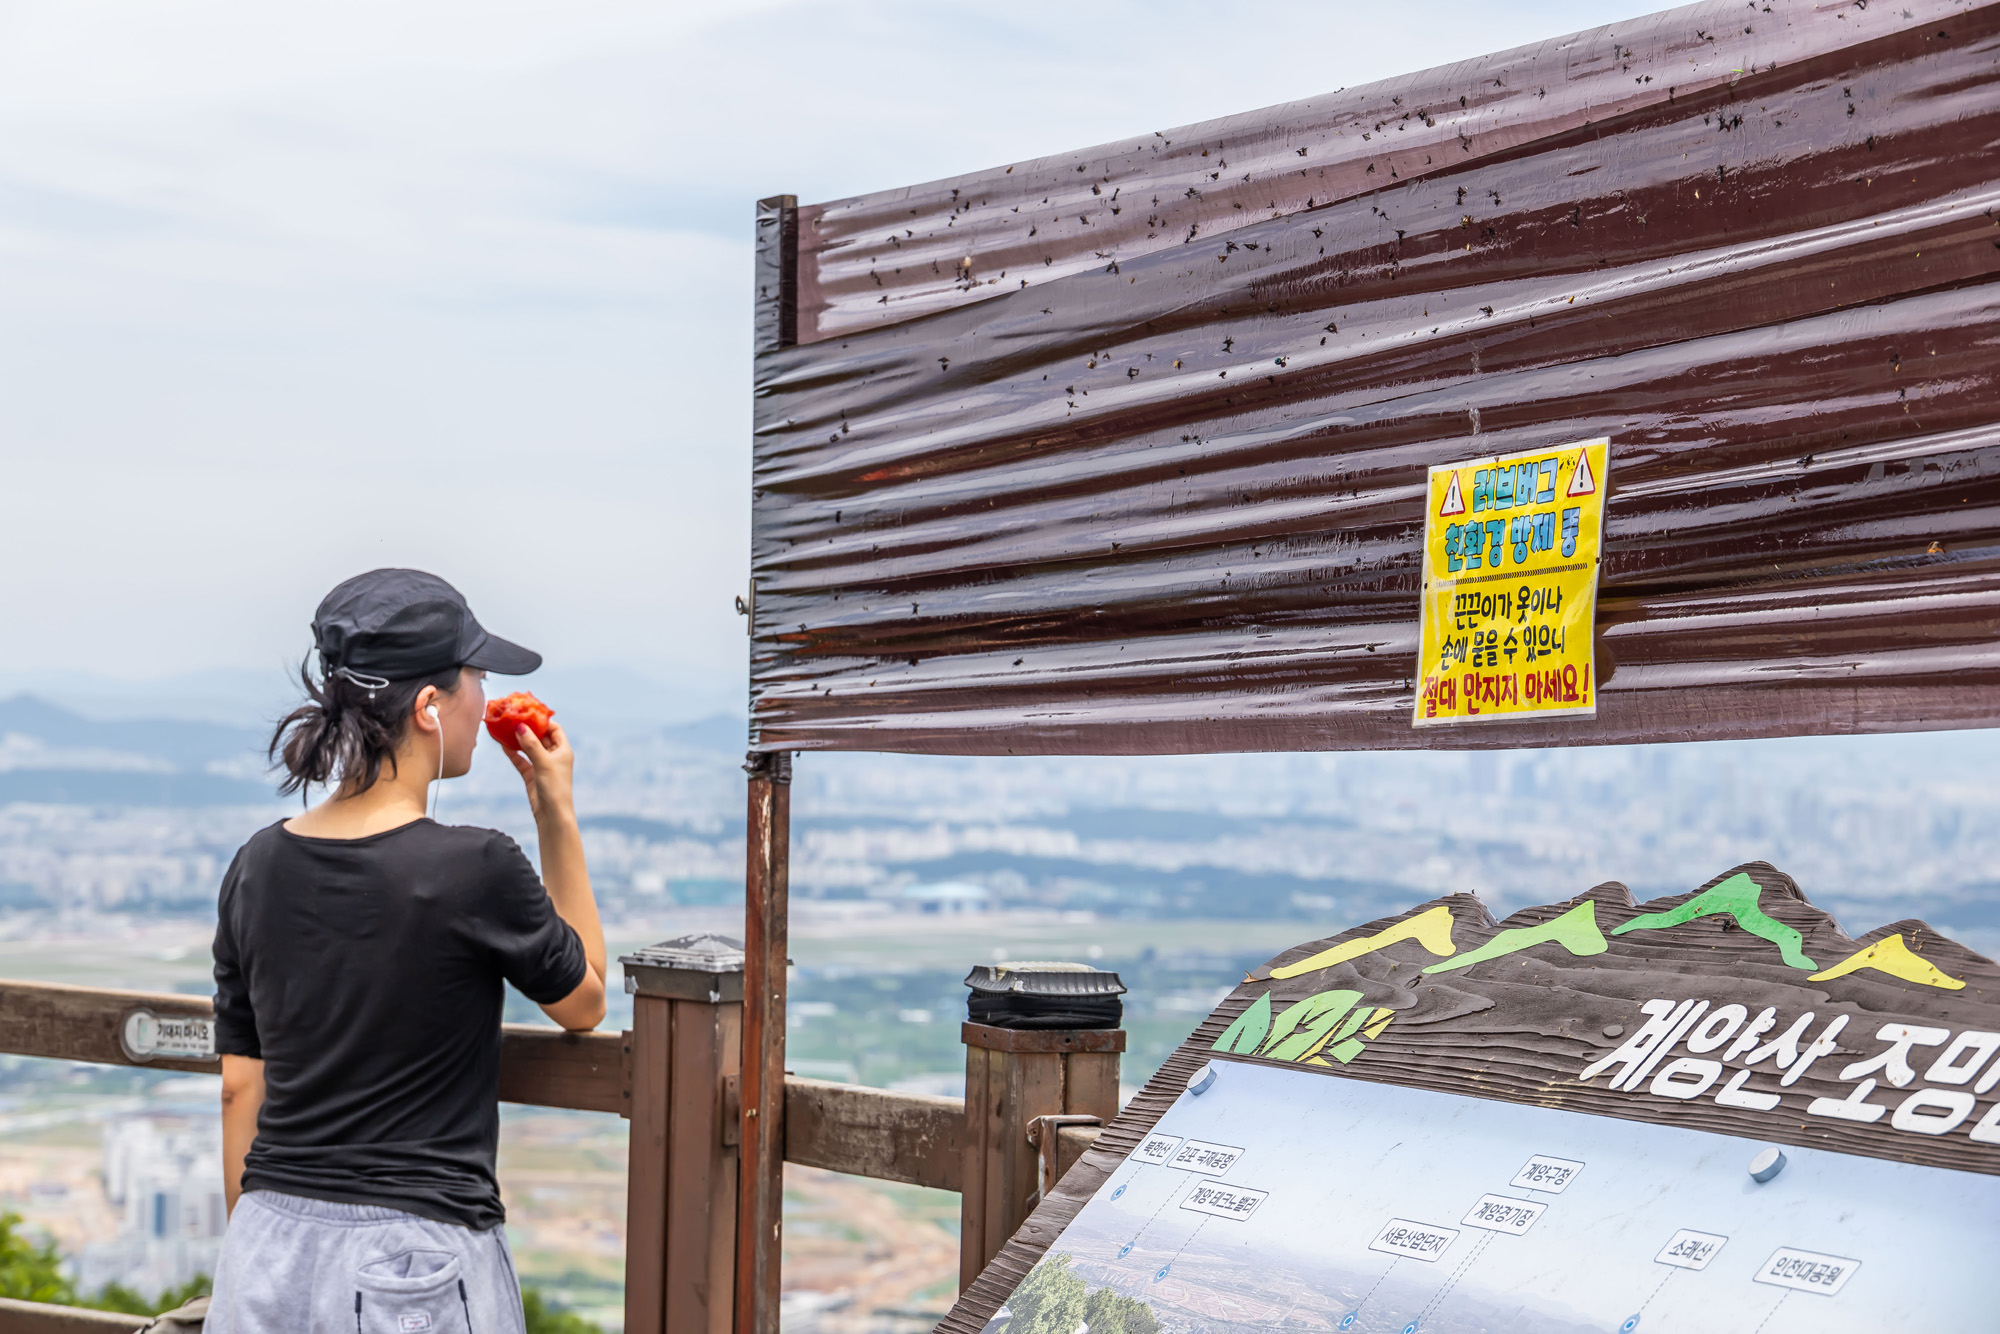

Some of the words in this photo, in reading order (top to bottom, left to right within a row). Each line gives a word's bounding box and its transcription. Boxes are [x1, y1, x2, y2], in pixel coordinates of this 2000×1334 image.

[1473, 458, 1558, 513] 러브버그
[1445, 519, 1506, 573] 친환경
[1510, 512, 1556, 564] 방제
[1561, 507, 1580, 558] 중
[1454, 592, 1512, 630] 끈끈이가
[1517, 585, 1562, 624] 옷이나
[1441, 634, 1468, 670] 손에
[1472, 629, 1498, 667] 묻을
[1504, 627, 1518, 664] 수
[1523, 625, 1565, 662] 있으니
[1422, 676, 1456, 717] 절대
[1464, 671, 1517, 715] 만지지
[1525, 663, 1589, 704] 마세요!
[1579, 999, 1850, 1111] 계양산
[1143, 1140, 1174, 1158] 북한산
[1176, 1146, 1201, 1163] 김포
[1196, 1149, 1237, 1170] 국제공항
[1522, 1163, 1574, 1186] 계양구청
[1189, 1187, 1216, 1204] 계양
[1474, 1202, 1536, 1227] 계양경기장
[1380, 1227, 1449, 1254] 서운산업단지
[1668, 1239, 1715, 1262] 소래산
[1769, 1257, 1845, 1286] 인천대공원
